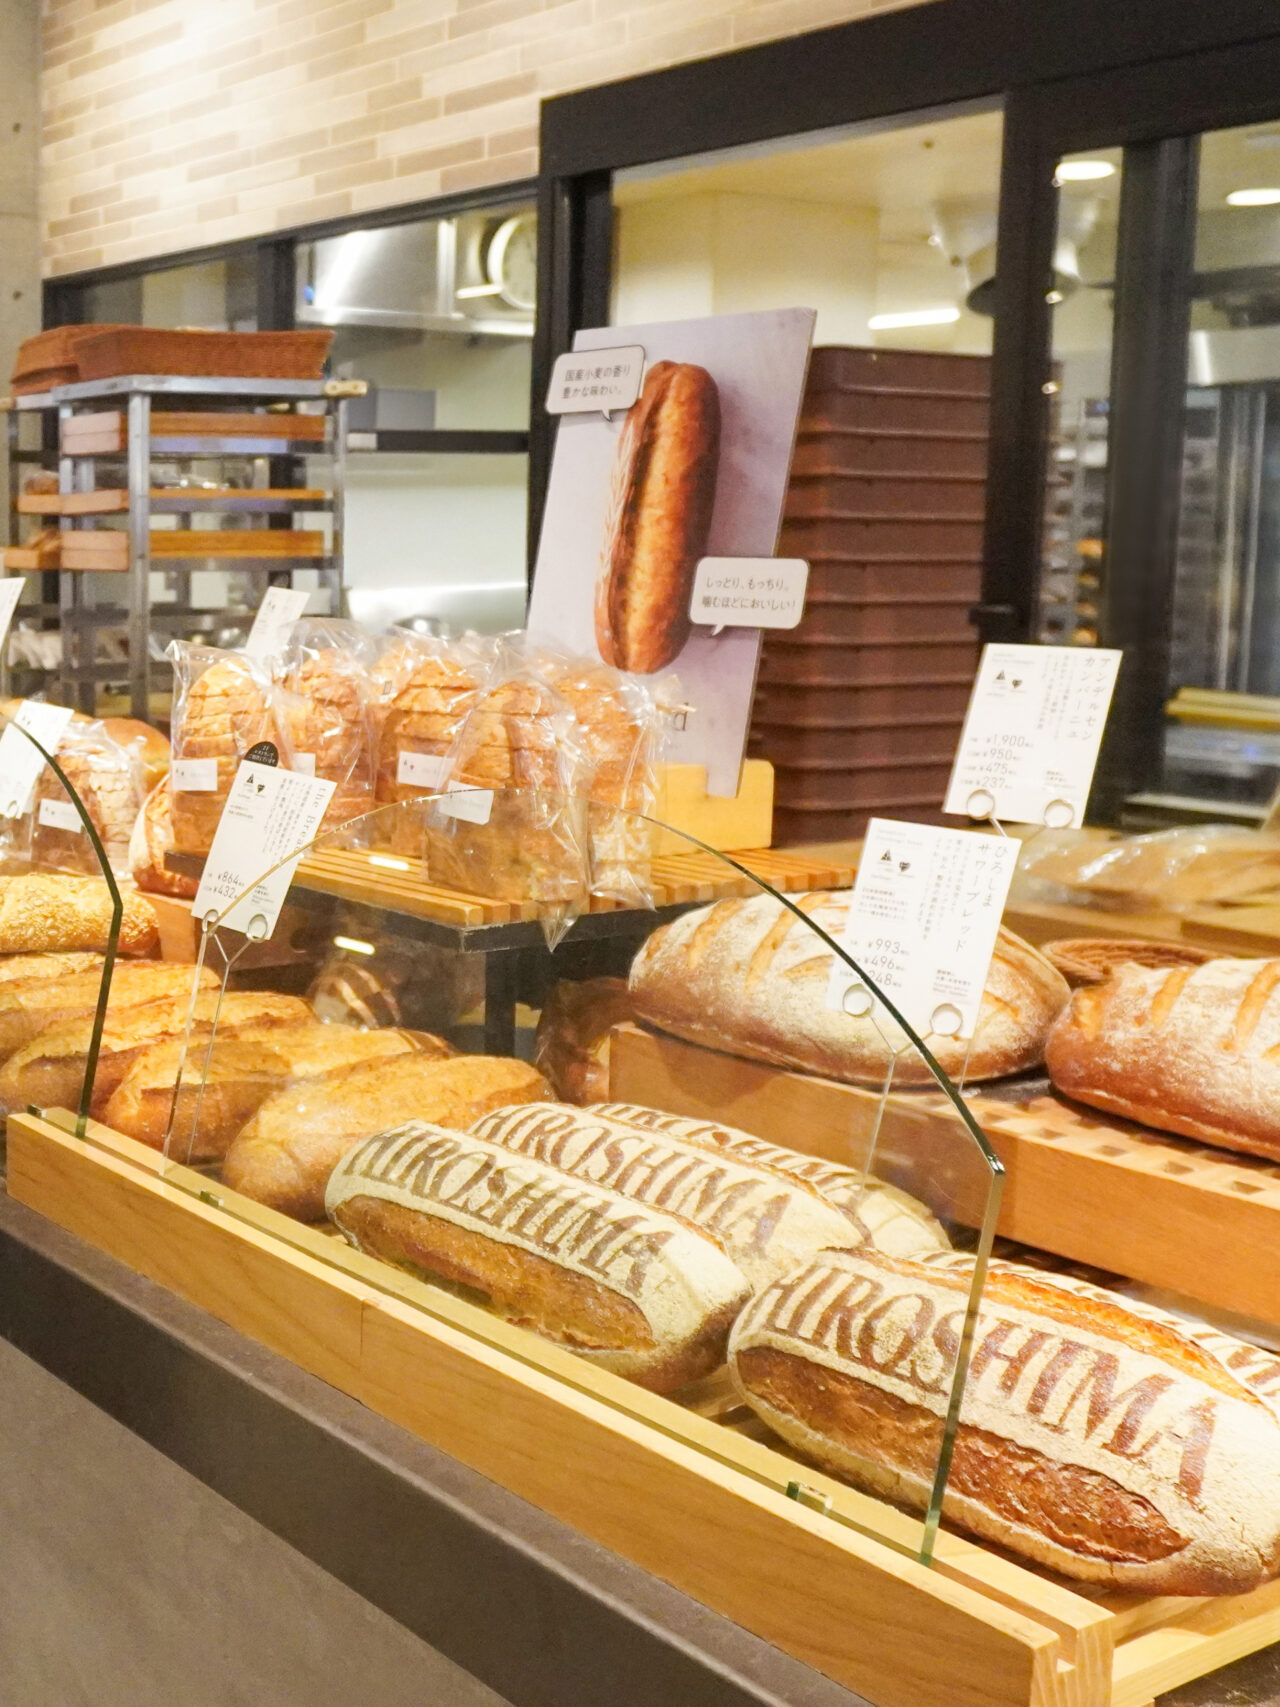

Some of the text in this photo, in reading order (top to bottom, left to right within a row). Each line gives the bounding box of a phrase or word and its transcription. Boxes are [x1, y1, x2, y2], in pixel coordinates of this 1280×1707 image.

[982, 846, 1008, 906] ひろしま
[342, 1126, 676, 1298] HIROSHIMA
[472, 1106, 792, 1259] HIROSHIMA
[738, 1263, 1218, 1504] HIROSHIMA
